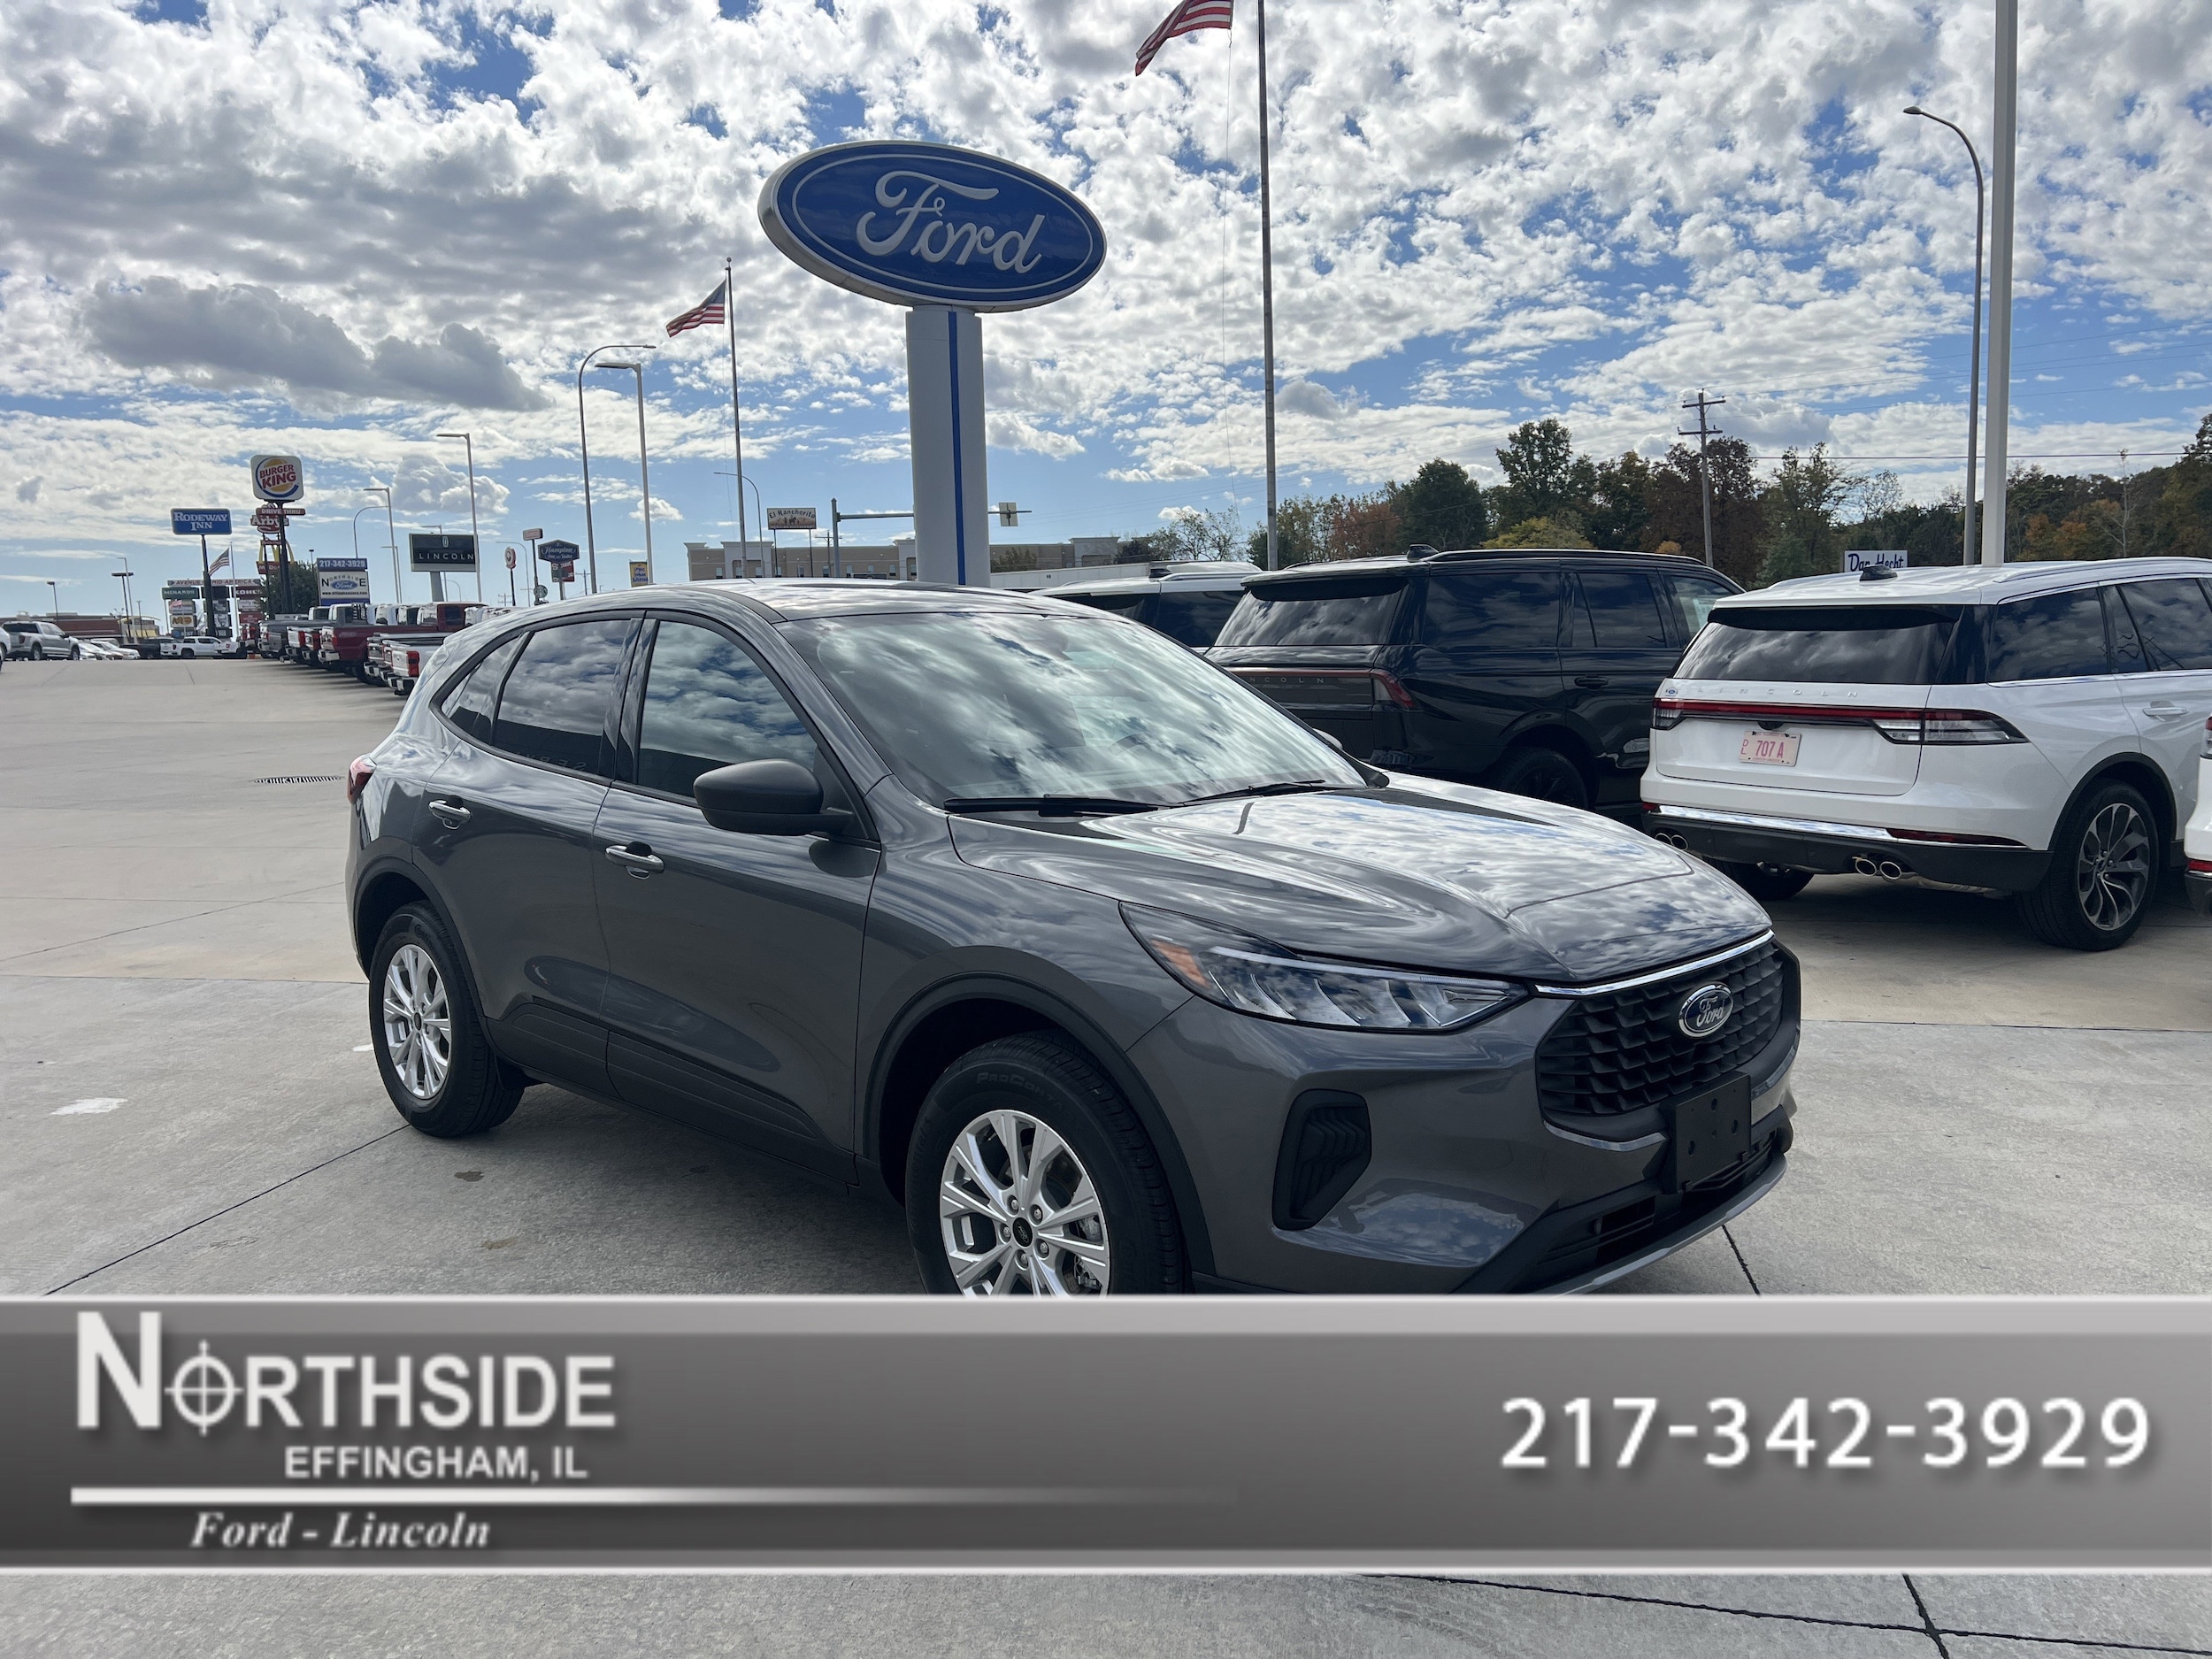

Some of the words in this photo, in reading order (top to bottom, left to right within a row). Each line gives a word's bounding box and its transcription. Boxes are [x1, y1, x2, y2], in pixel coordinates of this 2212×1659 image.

[856, 170, 1046, 274] Ford
[259, 464, 294, 479] BURGER
[261, 471, 296, 489] KING
[173, 511, 228, 522] RODEWAY
[777, 509, 816, 519] Rancherito
[190, 521, 213, 531] INN
[251, 515, 289, 528] Arbys
[541, 545, 577, 556] Hampton
[1698, 687, 1859, 698] LINCOLN
[1755, 740, 1776, 757] 707
[1777, 741, 1785, 758] A
[1696, 995, 1726, 1027] Ford
